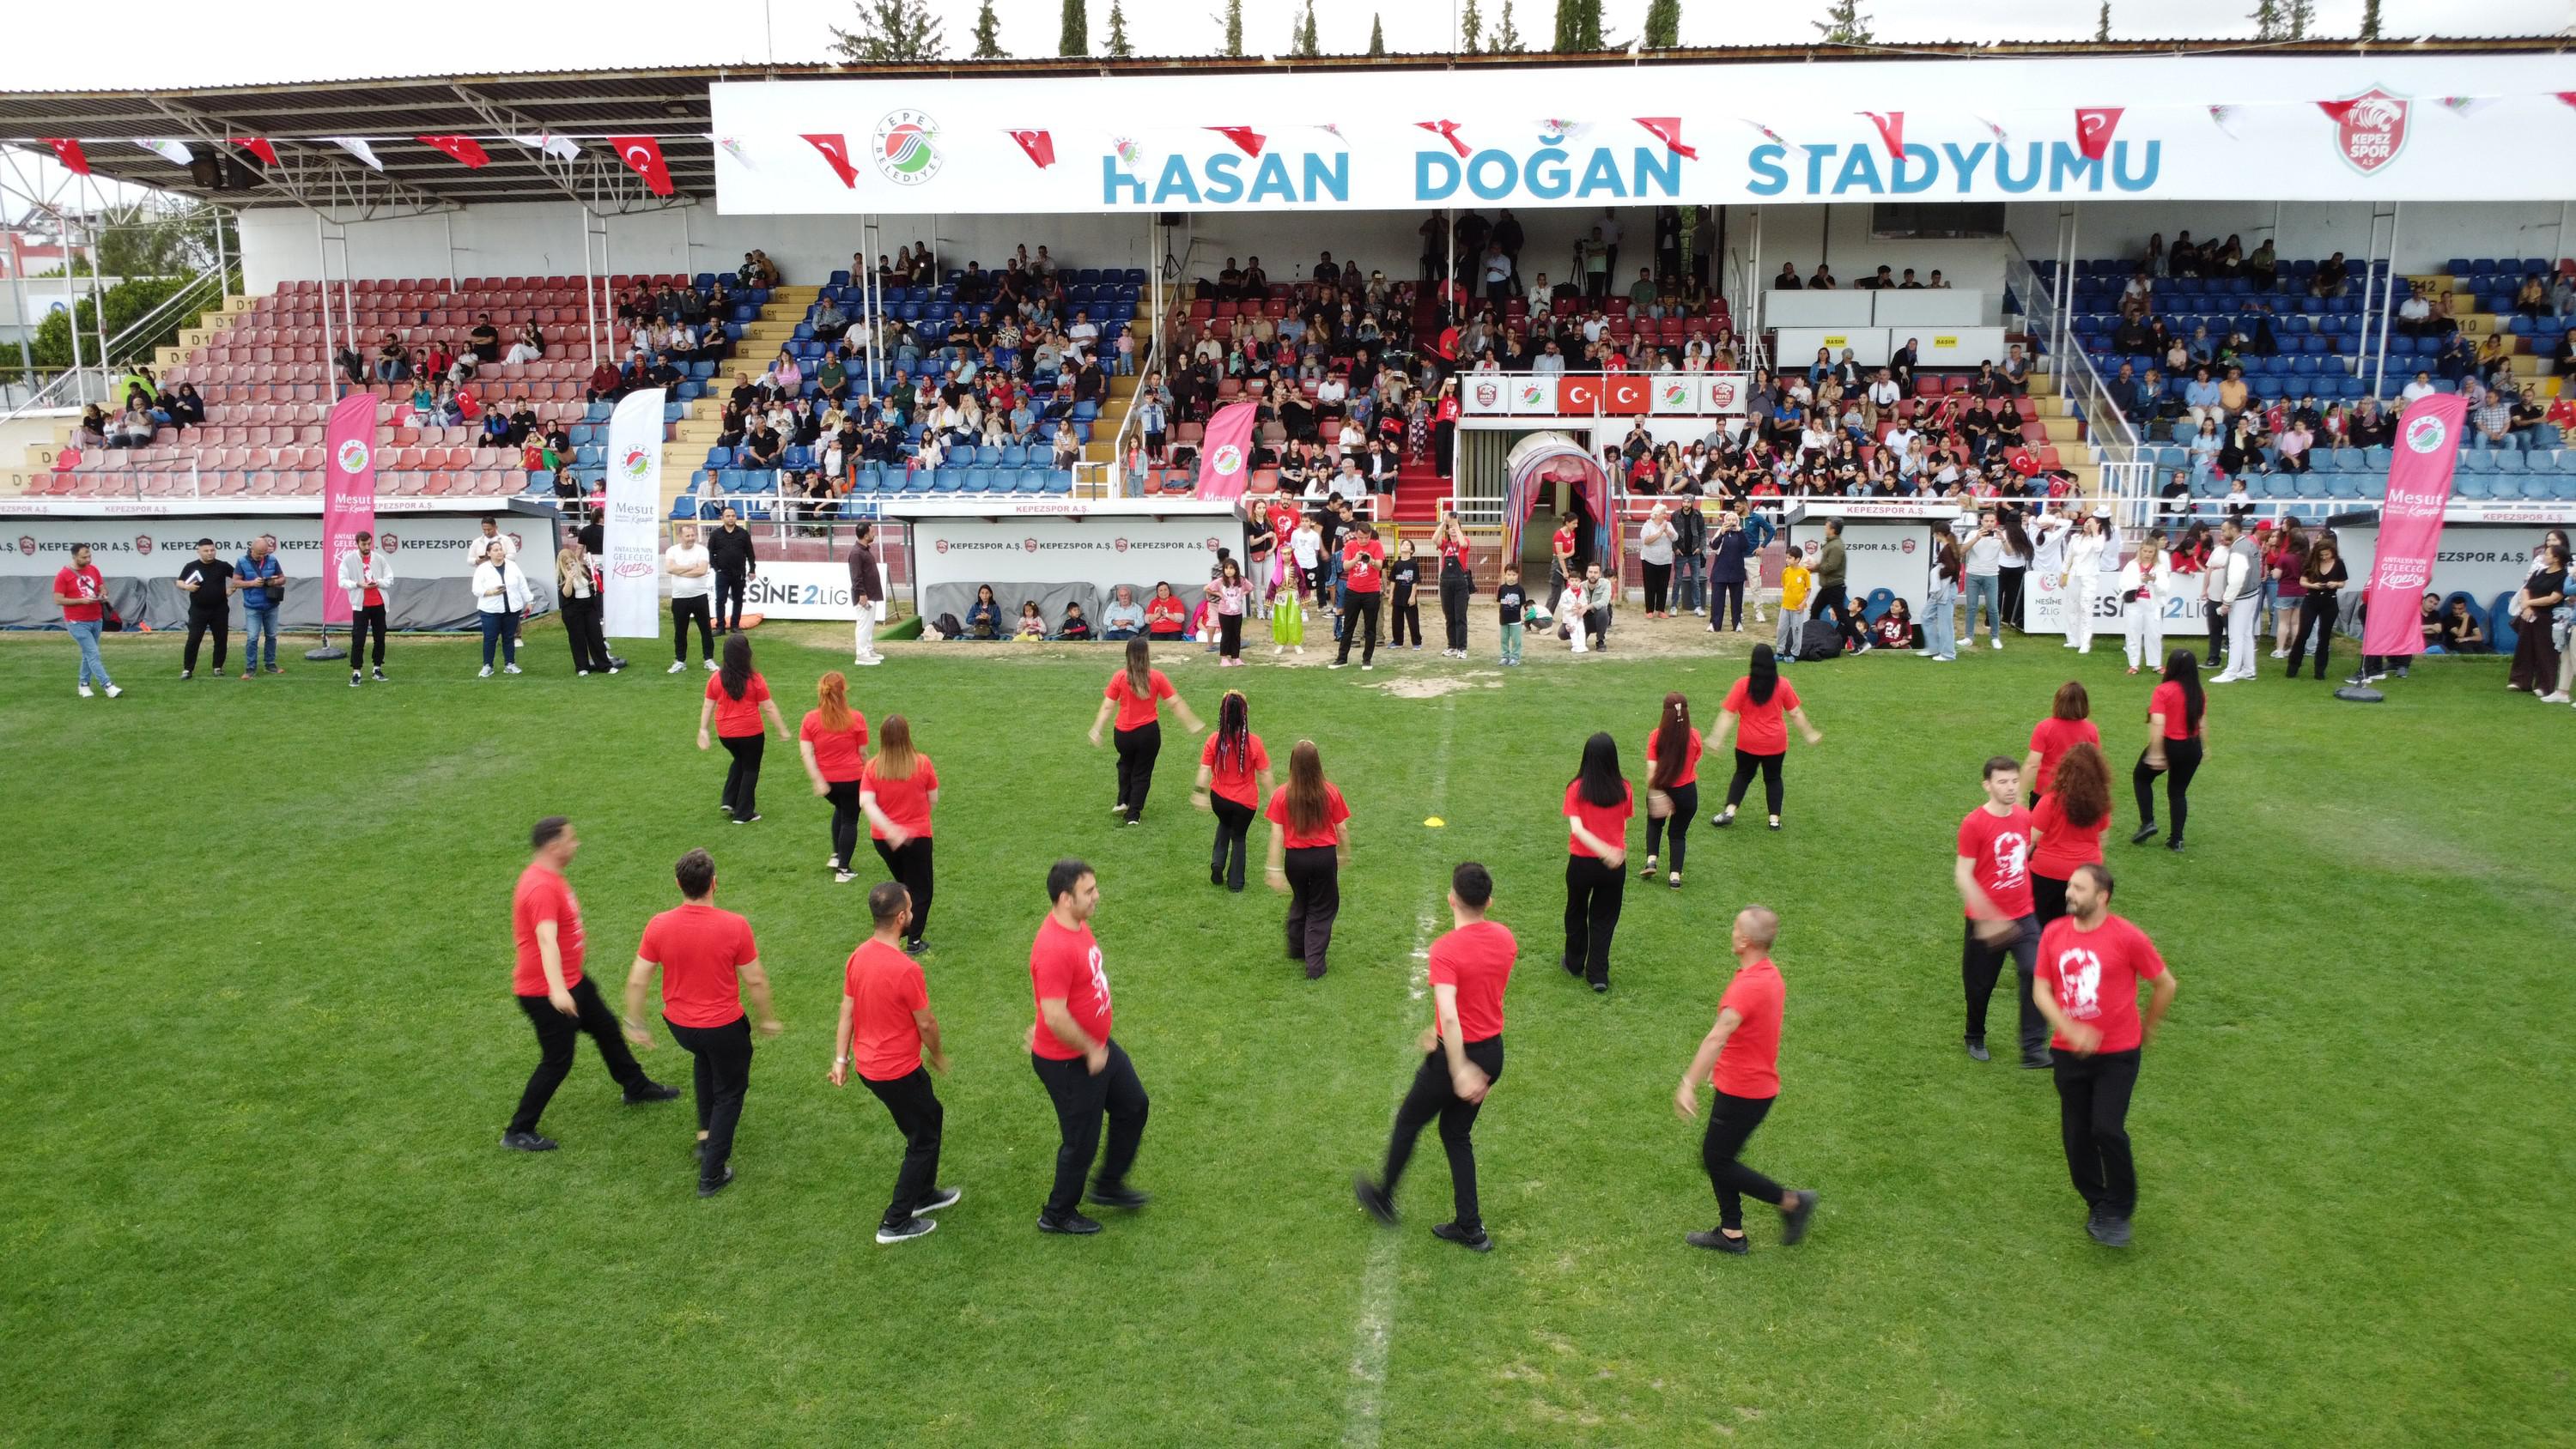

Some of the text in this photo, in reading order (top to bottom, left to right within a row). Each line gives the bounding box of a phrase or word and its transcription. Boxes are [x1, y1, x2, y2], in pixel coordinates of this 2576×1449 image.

[2352, 133, 2391, 145] KEPEZ
[2349, 144, 2391, 158] SPOR
[1103, 152, 1349, 204] HASAN
[1415, 135, 1681, 201] DOĞAN
[1746, 140, 2161, 196] STADYUMU
[335, 493, 371, 505] Mesut
[2387, 489, 2443, 506] Mesut
[616, 502, 653, 514] Mesut
[39, 543, 108, 551] KEPEPOR
[112, 542, 133, 553] A.Ş.
[161, 542, 231, 550] KEPEZOR
[1006, 542, 1023, 551] A.Ş.
[1096, 543, 1113, 551] A.Ş.
[1187, 542, 1204, 550] A.Ş.
[1881, 543, 1899, 552] A.Ş.
[2500, 552, 2529, 564] A.Ş.
[741, 577, 799, 604] ESİNE
[2035, 596, 2062, 605] NESİNE
[1885, 621, 1901, 640] 24
